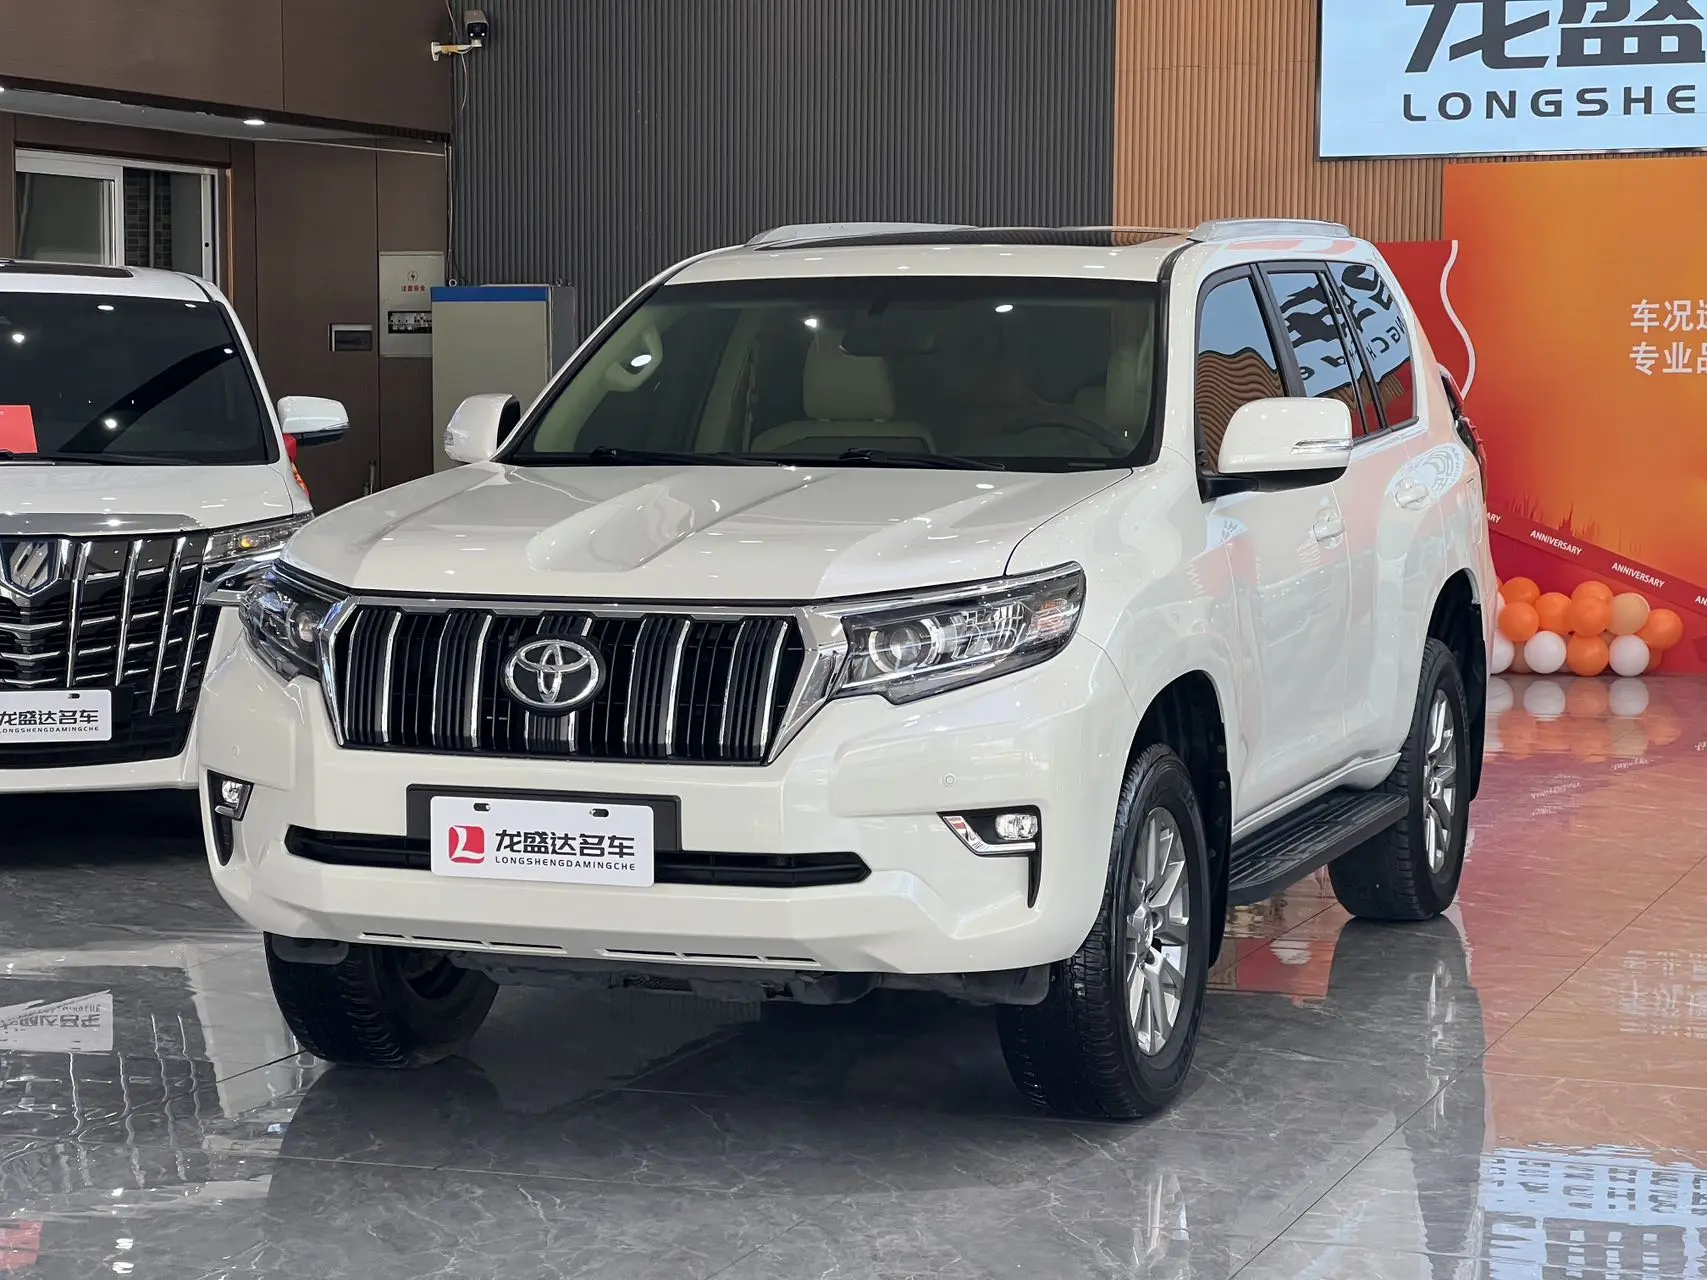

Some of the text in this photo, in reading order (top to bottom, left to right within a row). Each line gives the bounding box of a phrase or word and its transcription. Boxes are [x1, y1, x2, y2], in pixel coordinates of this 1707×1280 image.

[1403, 85, 1696, 121] LONGSHE
[1530, 530, 1582, 555] ANNIVERSARY
[1611, 562, 1665, 588] ANNIVERSARY
[0, 710, 98, 725] 龙盛达名车
[495, 829, 635, 859] 龙盛达名车
[495, 856, 636, 871] LONGSHENGDAMINGCHE
